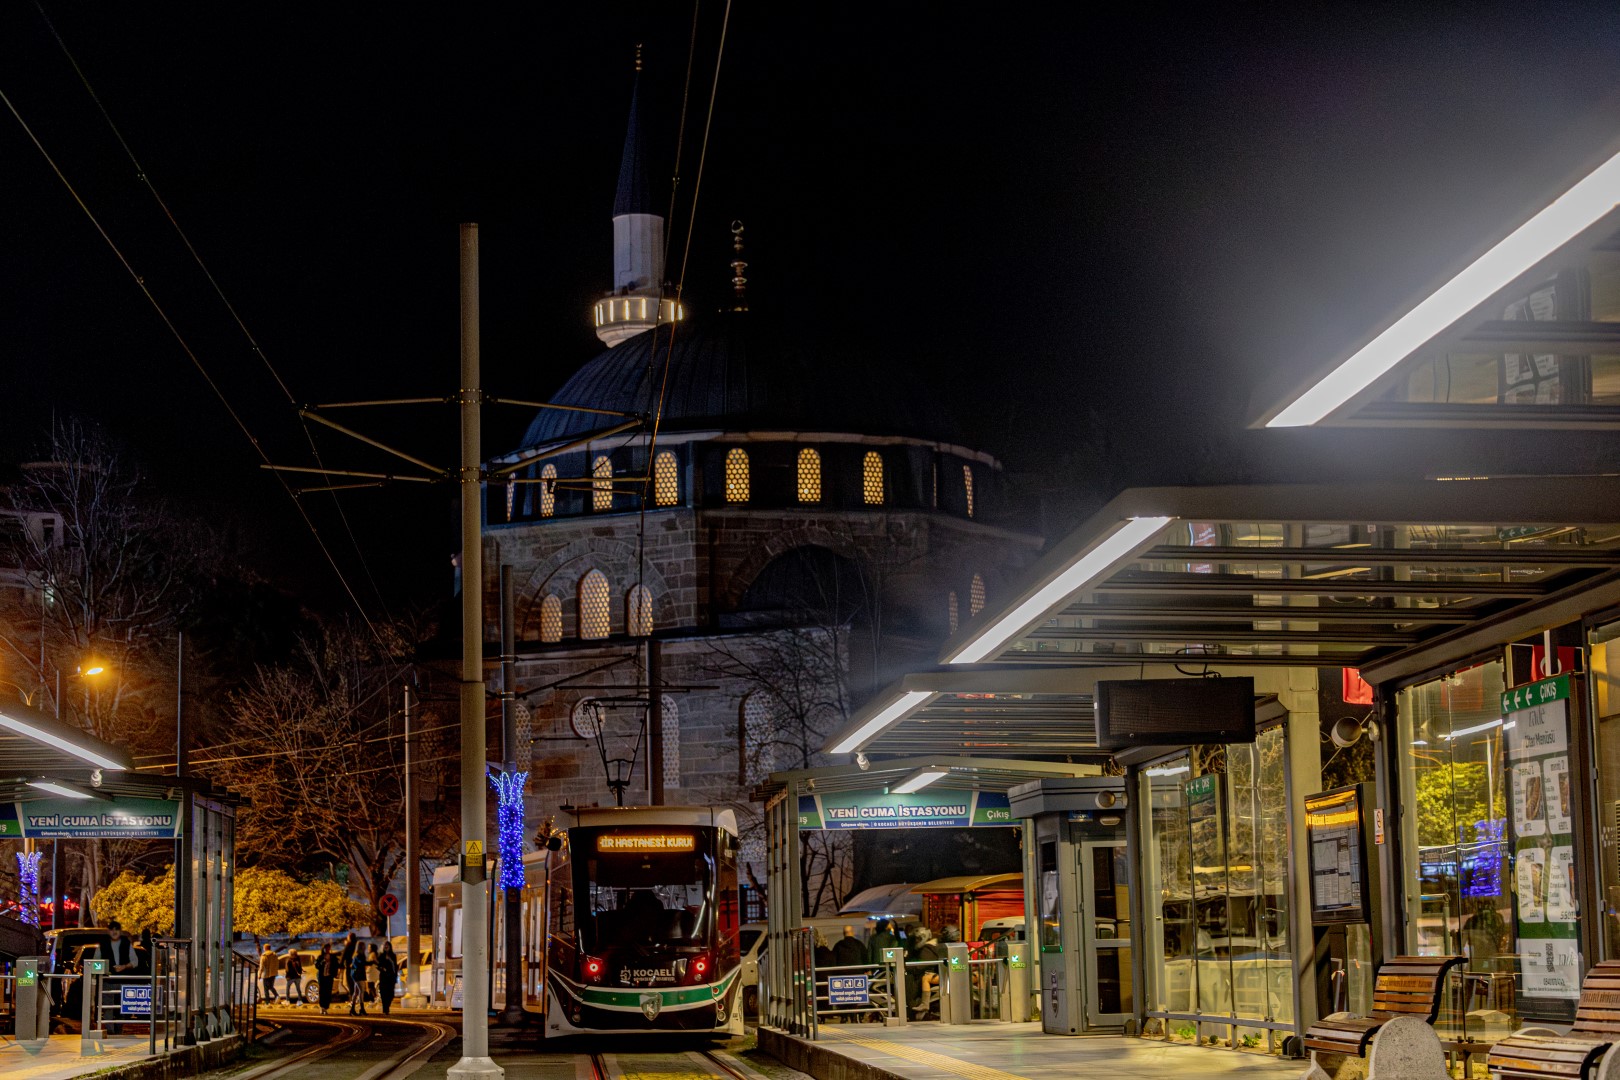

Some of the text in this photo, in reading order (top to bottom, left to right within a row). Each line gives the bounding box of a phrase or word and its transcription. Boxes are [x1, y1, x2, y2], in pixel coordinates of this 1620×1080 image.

[1540, 681, 1556, 702] ÇIKIŞ
[829, 804, 965, 818] YENİ CUMA İSTASYONU
[987, 810, 1009, 821] Çıkış
[29, 813, 171, 826] YENİ CUMA İSTASYONU
[615, 835, 666, 848] HASTANESİ
[633, 968, 675, 978] KOCAELİ
